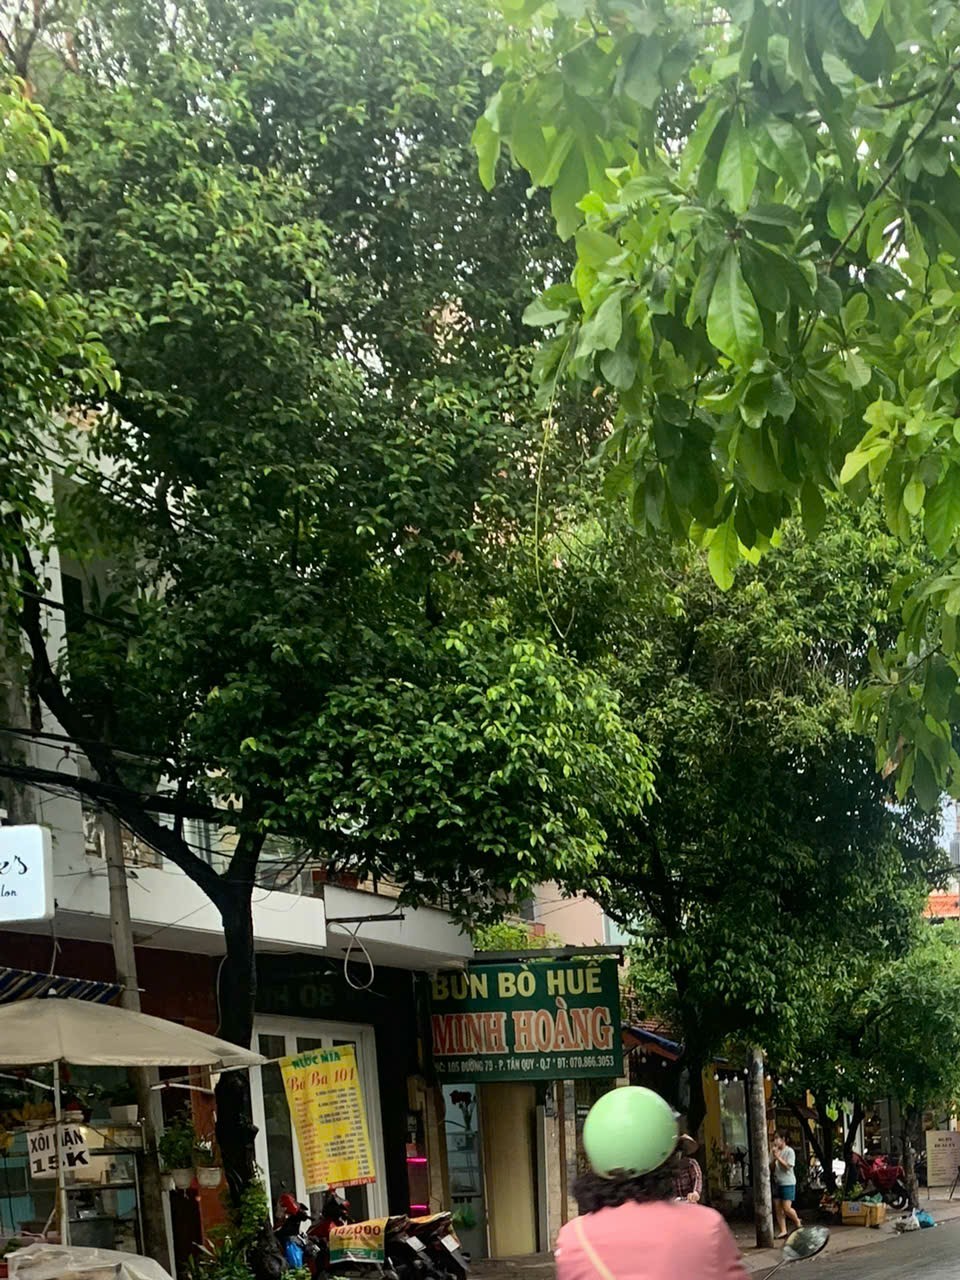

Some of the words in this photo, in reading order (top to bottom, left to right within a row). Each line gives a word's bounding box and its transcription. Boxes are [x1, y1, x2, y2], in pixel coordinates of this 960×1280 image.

[498, 965, 536, 998] BÒ
[432, 1012, 509, 1055] MINH
[512, 996, 614, 1053] HOÀNG
[485, 1060, 493, 1072] 79
[507, 1056, 520, 1071] TÂN
[557, 1057, 569, 1069] ĐT:
[30, 1132, 50, 1154] XÔI
[32, 1150, 89, 1174] 15K
